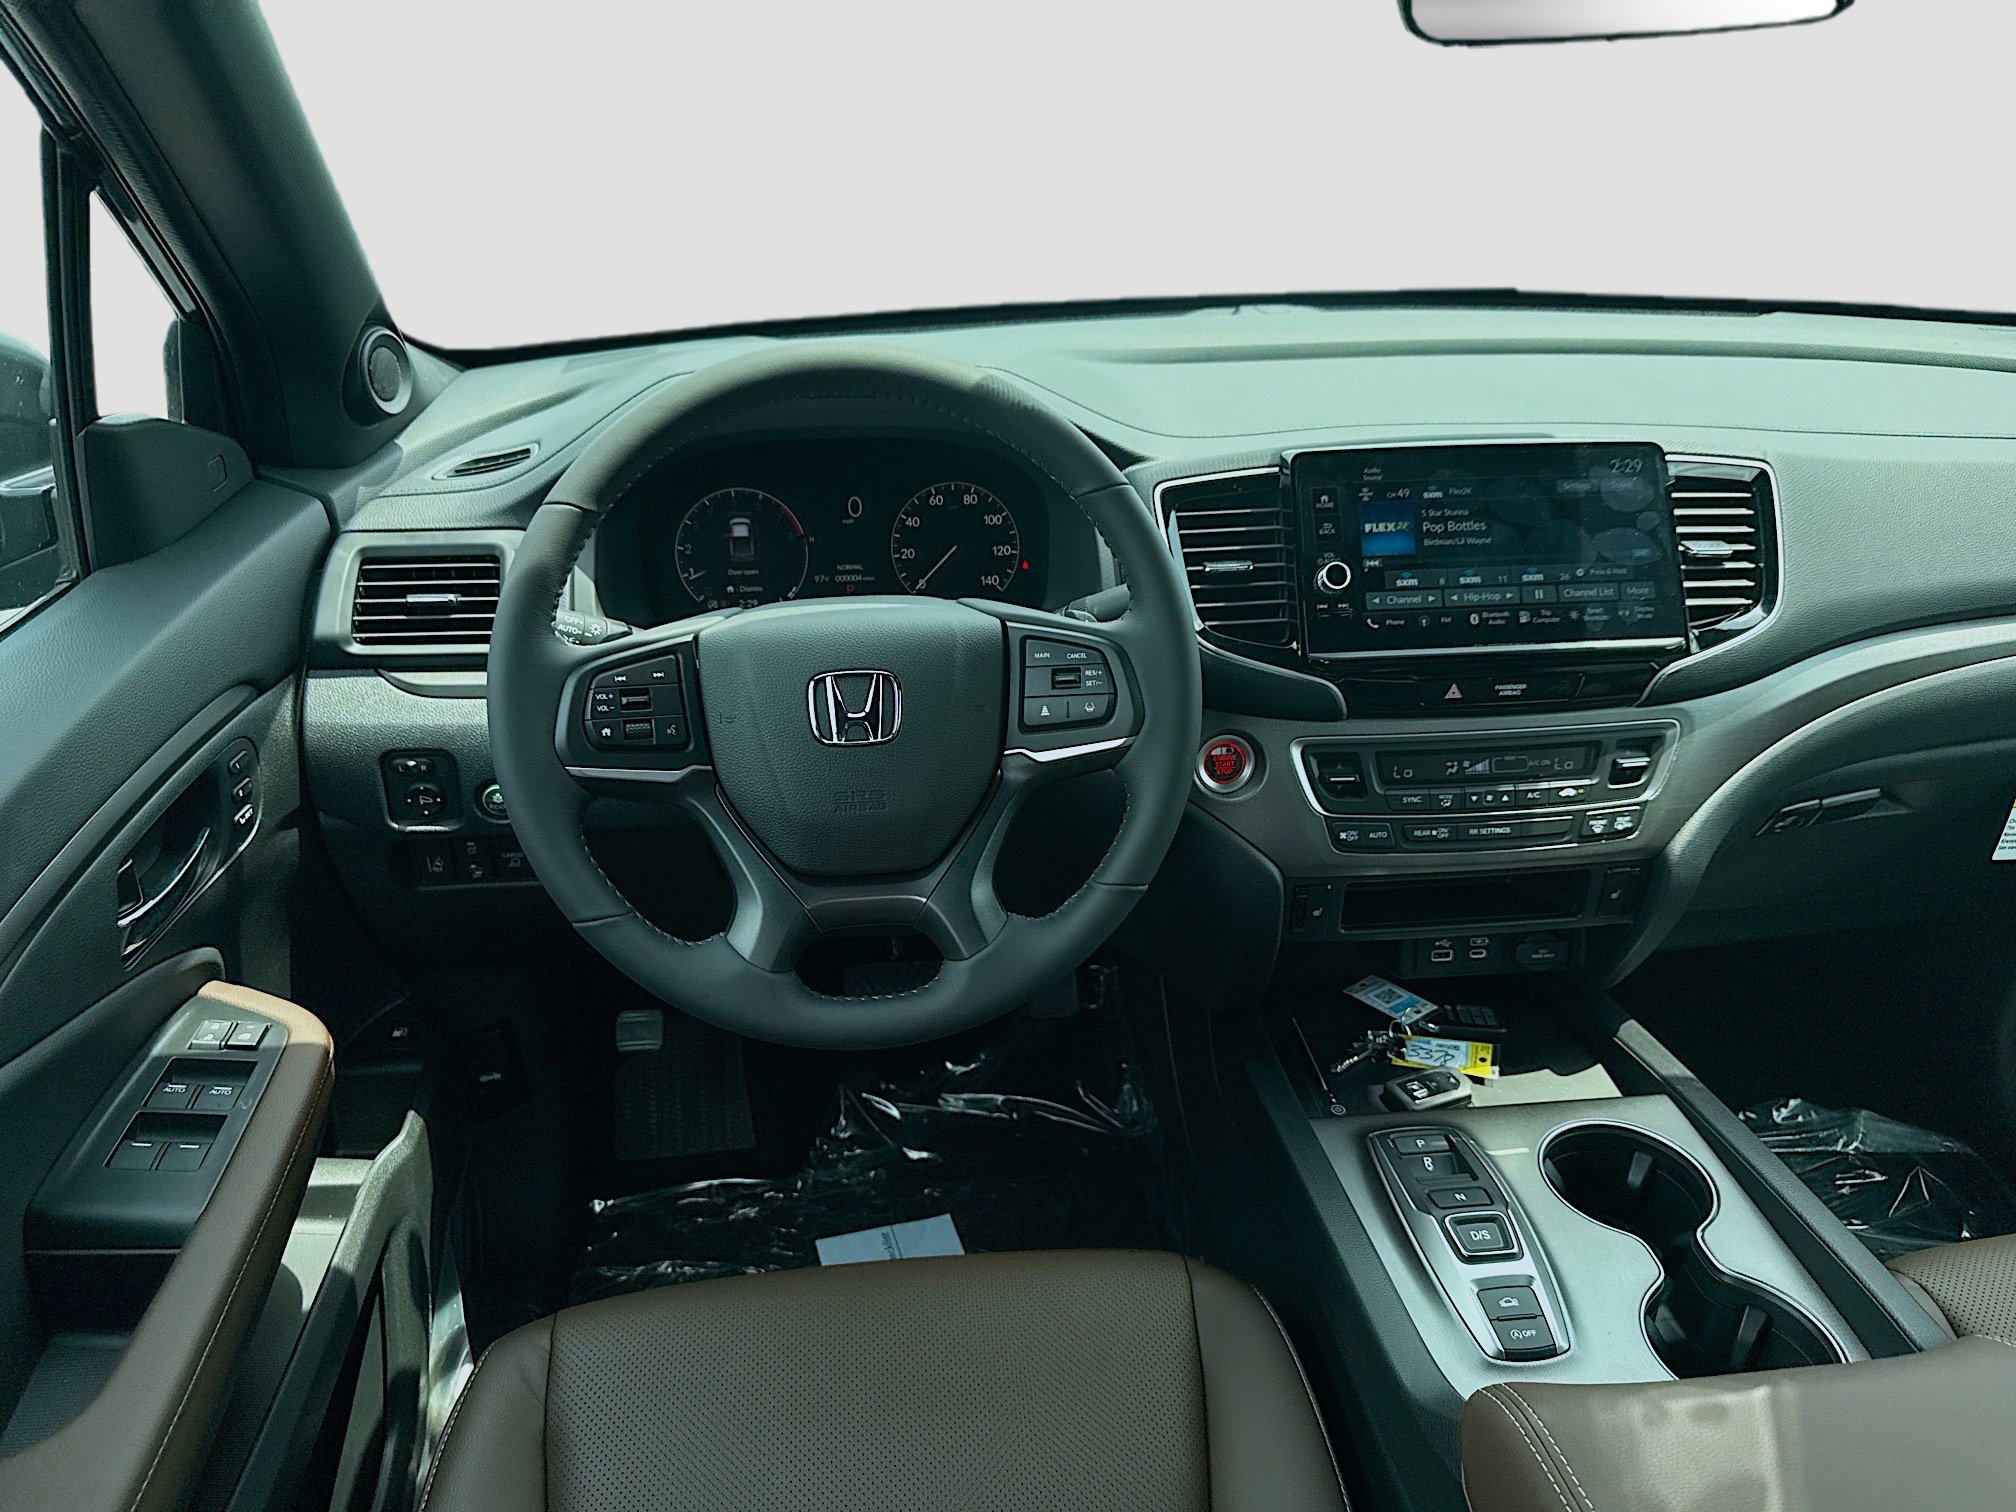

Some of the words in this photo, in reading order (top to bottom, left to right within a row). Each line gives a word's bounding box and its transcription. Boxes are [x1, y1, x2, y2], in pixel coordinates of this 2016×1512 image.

[1609, 458, 1643, 473] 2:29
[1422, 491, 1443, 499] sxm
[929, 495, 944, 506] 60
[963, 495, 978, 505] 80
[848, 496, 862, 518] 0
[1428, 508, 1443, 516] Star
[905, 517, 920, 528] 40
[983, 514, 1003, 526] 100
[1422, 521, 1445, 533] Pop
[1447, 520, 1488, 532] Bottles
[1466, 537, 1492, 546] Wayne
[685, 544, 692, 555] 2
[901, 548, 915, 559] 20
[992, 545, 1011, 556] 120
[727, 568, 742, 576] Door
[743, 569, 760, 577] open
[980, 575, 1000, 587] 140
[1458, 575, 1482, 584] sxm
[1521, 573, 1544, 582] sxm
[1395, 578, 1419, 587] sxm
[1563, 588, 1598, 597] Channel
[1599, 587, 1615, 596] List
[1626, 587, 1650, 595] More
[1386, 594, 1422, 604] Channel
[1463, 591, 1502, 602] Hip-Hop
[739, 599, 758, 608] 2:29
[565, 615, 579, 625] OFF
[558, 624, 578, 635] AUTO
[398, 765, 405, 773] L
[420, 764, 427, 772] R
[1402, 796, 1423, 804] SYNC
[1368, 831, 1388, 839] AUTO
[1413, 829, 1431, 837] REAR
[1468, 828, 1479, 836] RR
[1480, 827, 1512, 836] SETTINGS
[1416, 1139, 1425, 1148] P
[1423, 1156, 1433, 1167] R
[1454, 1193, 1467, 1201] N
[1469, 1230, 1491, 1241] D/S
[1521, 1329, 1537, 1337] OFF
